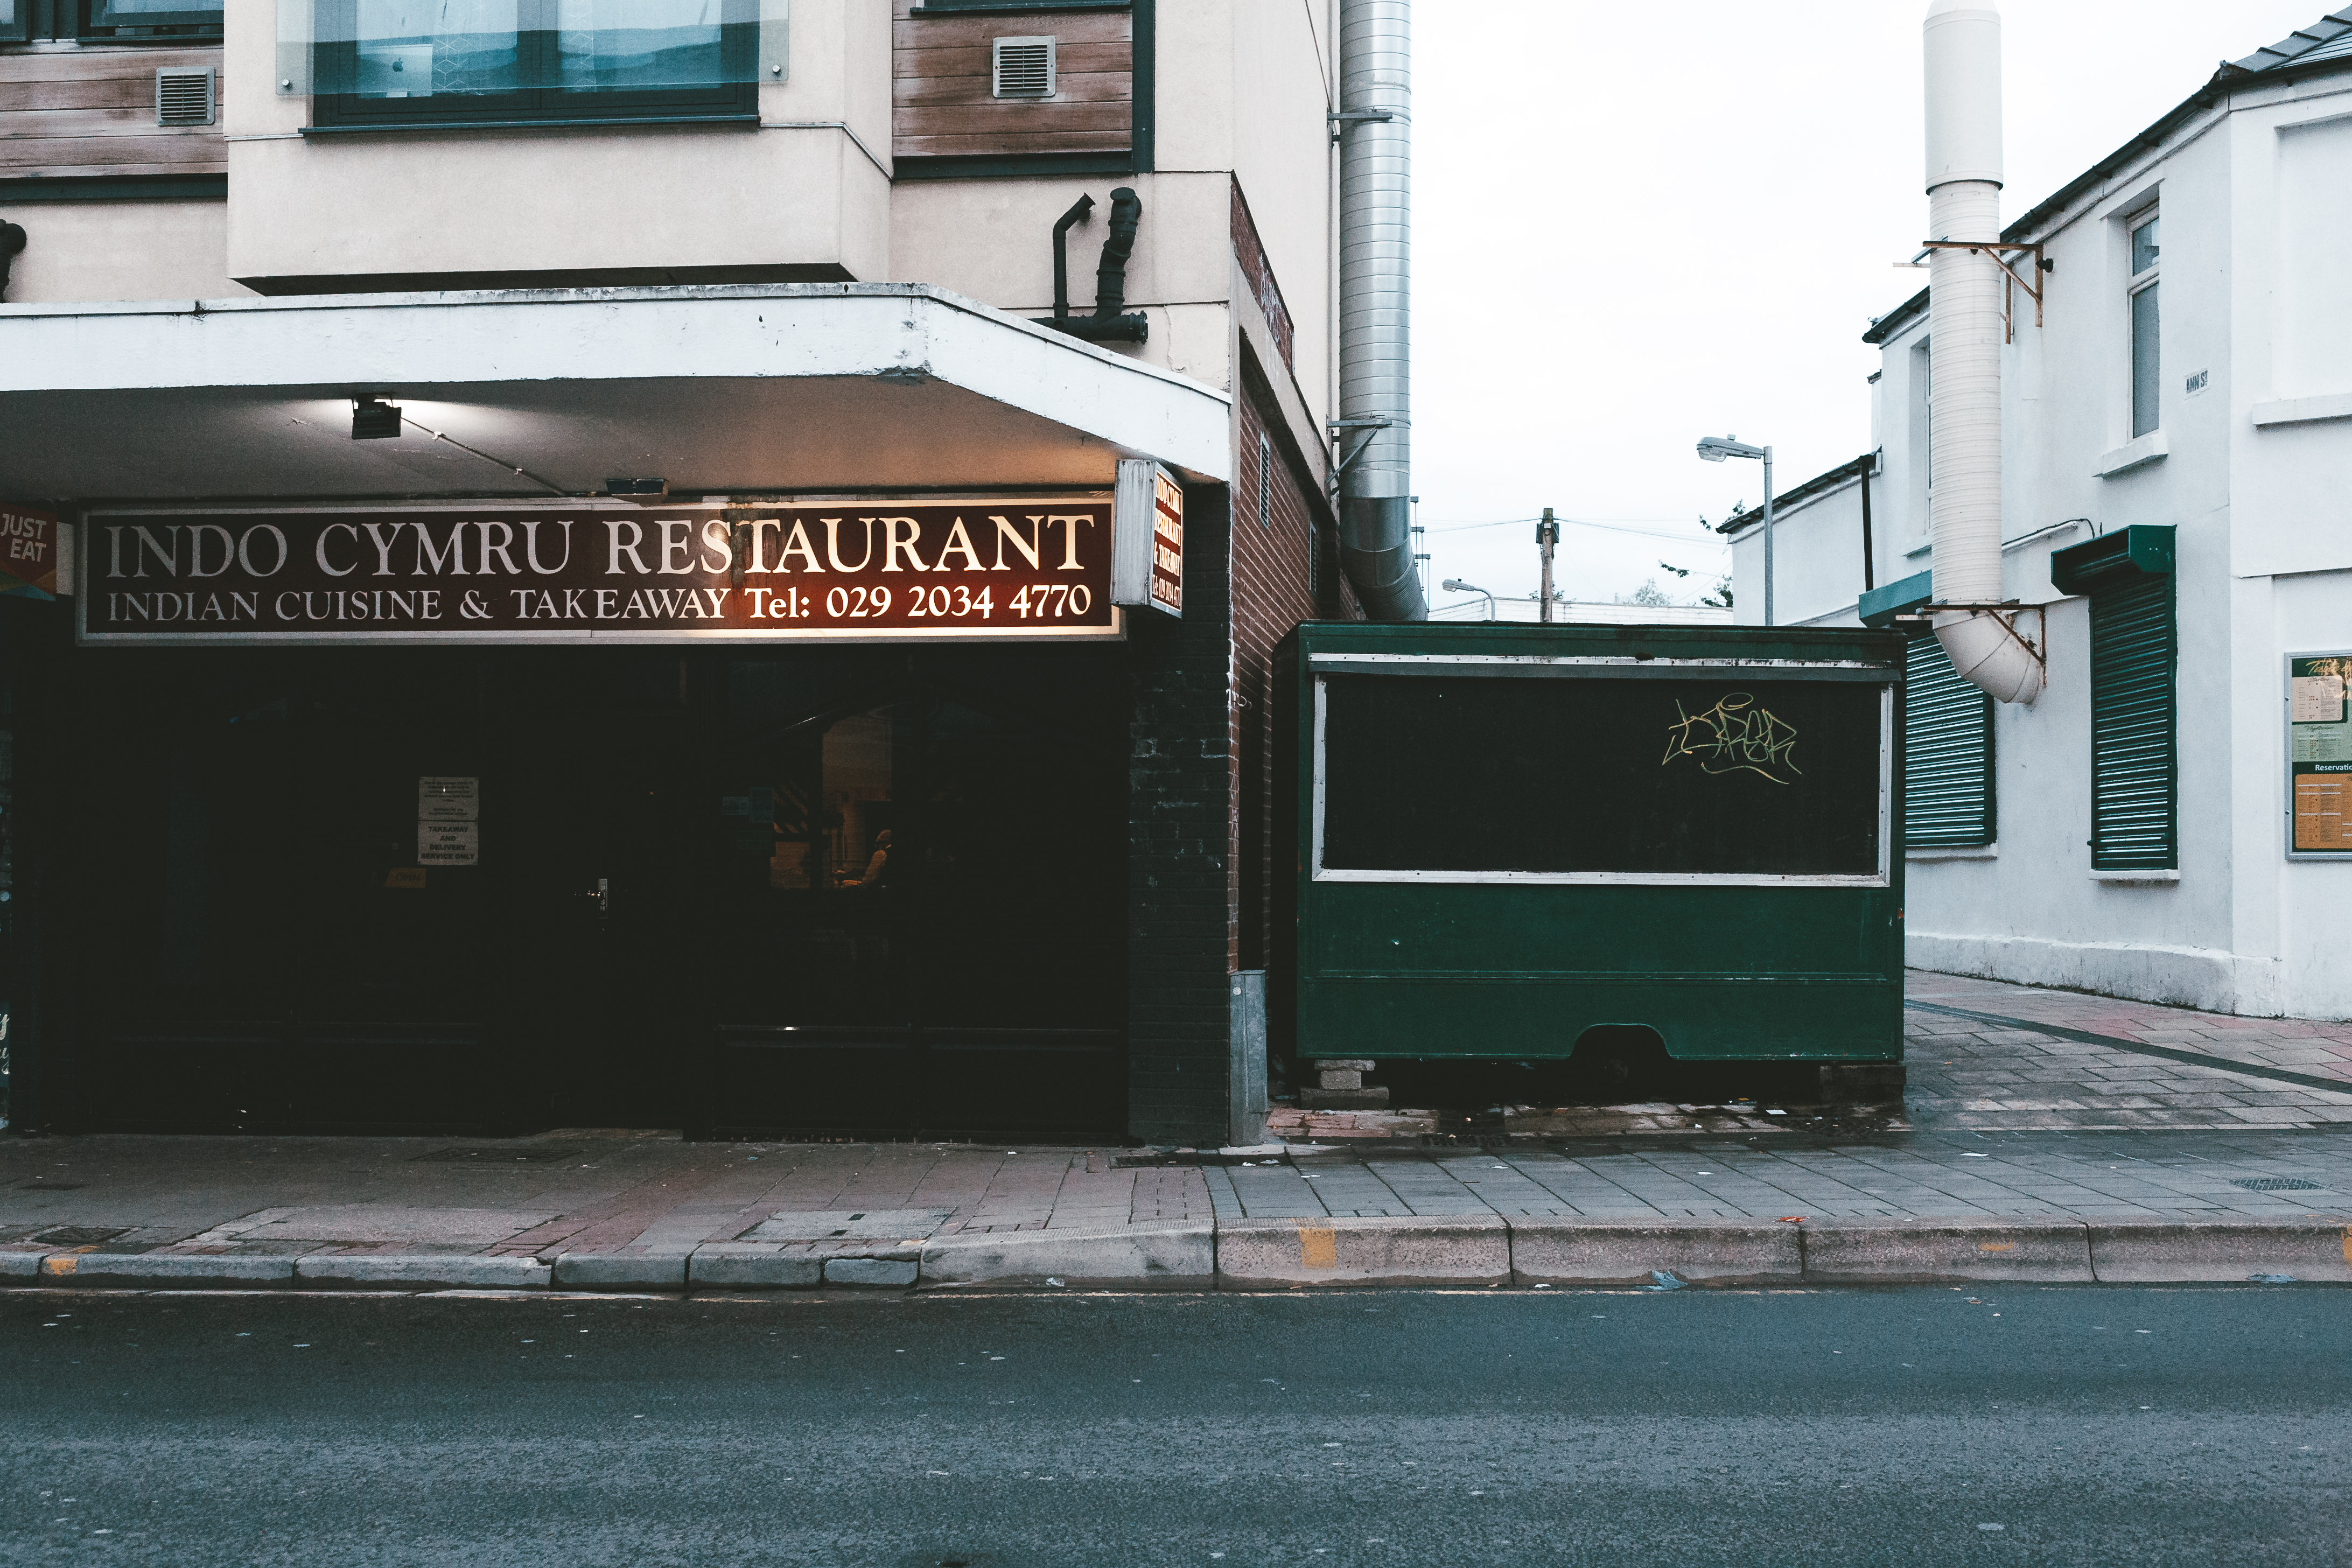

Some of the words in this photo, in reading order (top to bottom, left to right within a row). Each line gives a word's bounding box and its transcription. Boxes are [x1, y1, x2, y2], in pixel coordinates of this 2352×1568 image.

[2186, 374, 2199, 394] ANN
[0, 513, 47, 539] JUST
[1154, 507, 1181, 547] RESTAURANT
[10, 538, 47, 562] EAT
[104, 524, 287, 577] INDO
[316, 520, 574, 577] CYMRU
[602, 514, 1094, 575] RESTAURANT
[1159, 544, 1181, 577] TAKEAWAY
[108, 592, 259, 620] INDIAN
[275, 590, 442, 620] CUISINE
[459, 590, 493, 619] &
[510, 587, 731, 620] TAKEAWAY
[744, 586, 810, 618] Tel:
[826, 586, 892, 618] 029
[908, 585, 994, 619] 2034
[1009, 584, 1091, 618] 4770
